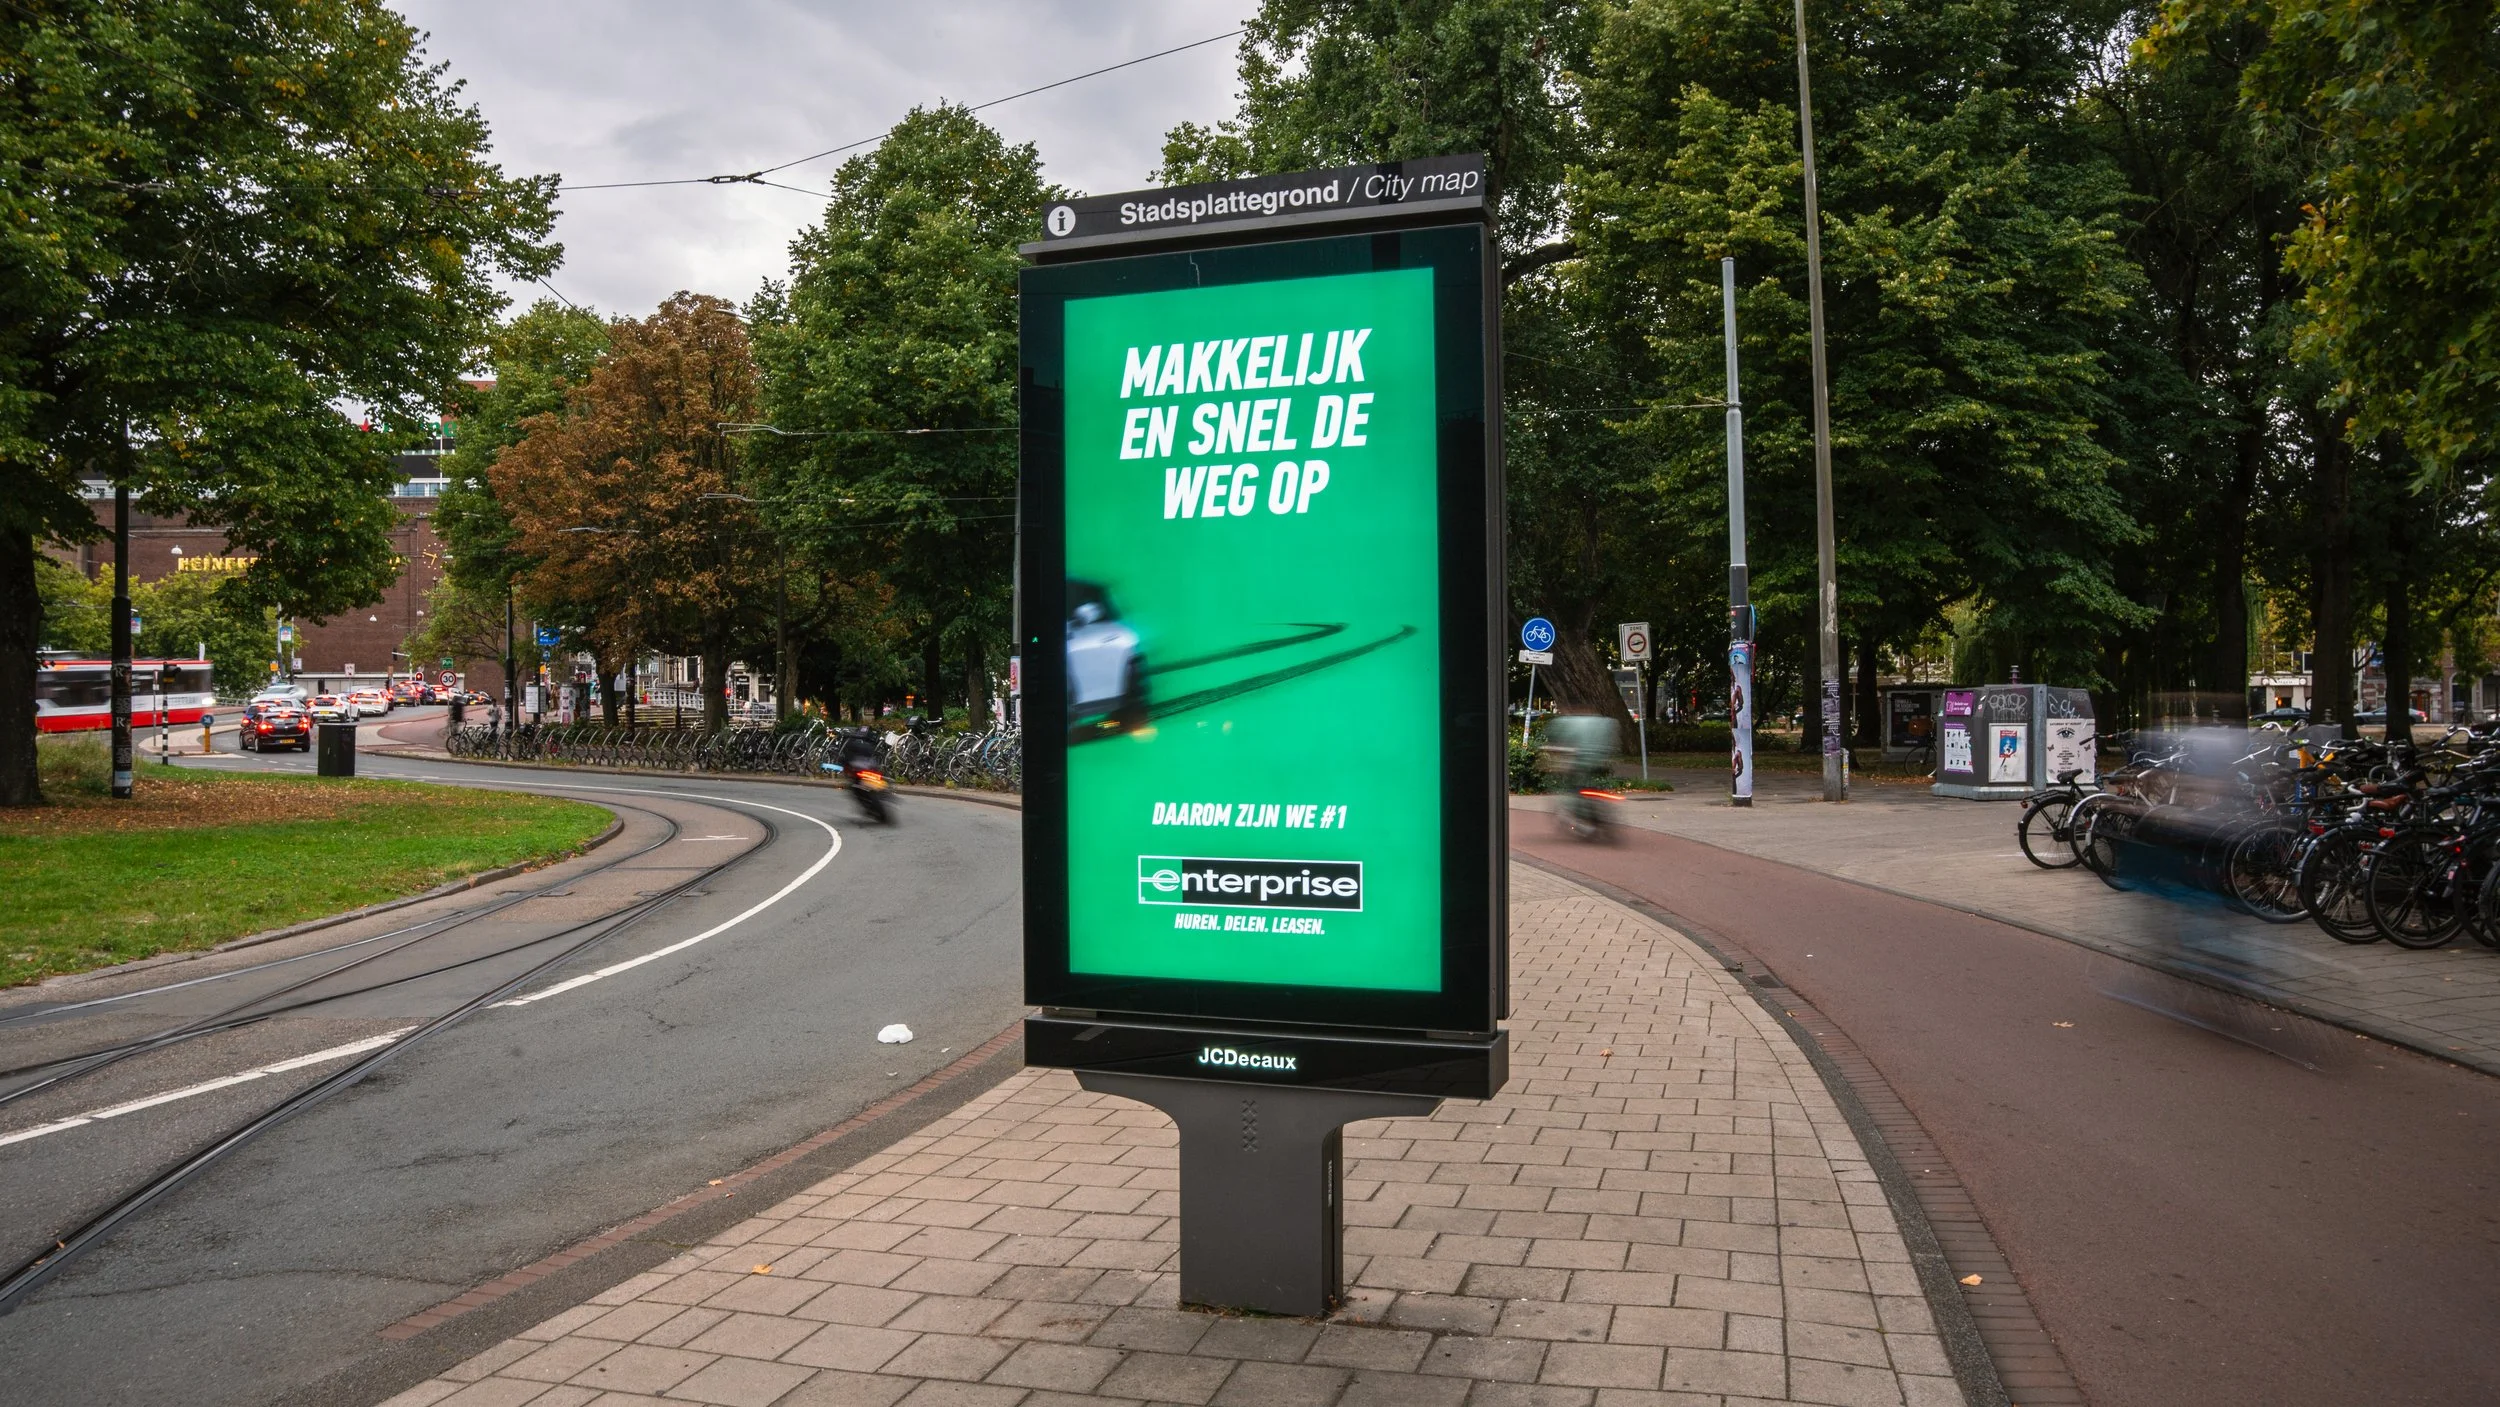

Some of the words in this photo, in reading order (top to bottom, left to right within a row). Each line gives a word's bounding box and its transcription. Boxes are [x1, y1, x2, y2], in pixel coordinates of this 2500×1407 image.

[1120, 180, 1339, 225] Stadsplattegrond
[1346, 177, 1360, 204] /
[1365, 173, 1412, 201] City
[1421, 170, 1479, 196] map
[1120, 328, 1373, 399] MAKKELIJK
[1119, 405, 1179, 460] EN
[1188, 398, 1297, 456] SNEL
[1311, 392, 1375, 449] DE
[1163, 464, 1260, 520] WEG
[1268, 459, 1330, 515] OP
[443, 675, 454, 683] 30
[1152, 802, 1233, 827] DAAROM
[1235, 803, 1281, 828] ZIJN
[1285, 804, 1317, 829] WE
[1320, 805, 1348, 829] #1
[1151, 869, 1359, 902] enterprise
[1174, 913, 1221, 931] HUREN.
[1223, 915, 1269, 933] DELEN.
[1272, 917, 1325, 935] LEASEN.
[1199, 1047, 1296, 1070] JCDecaux
